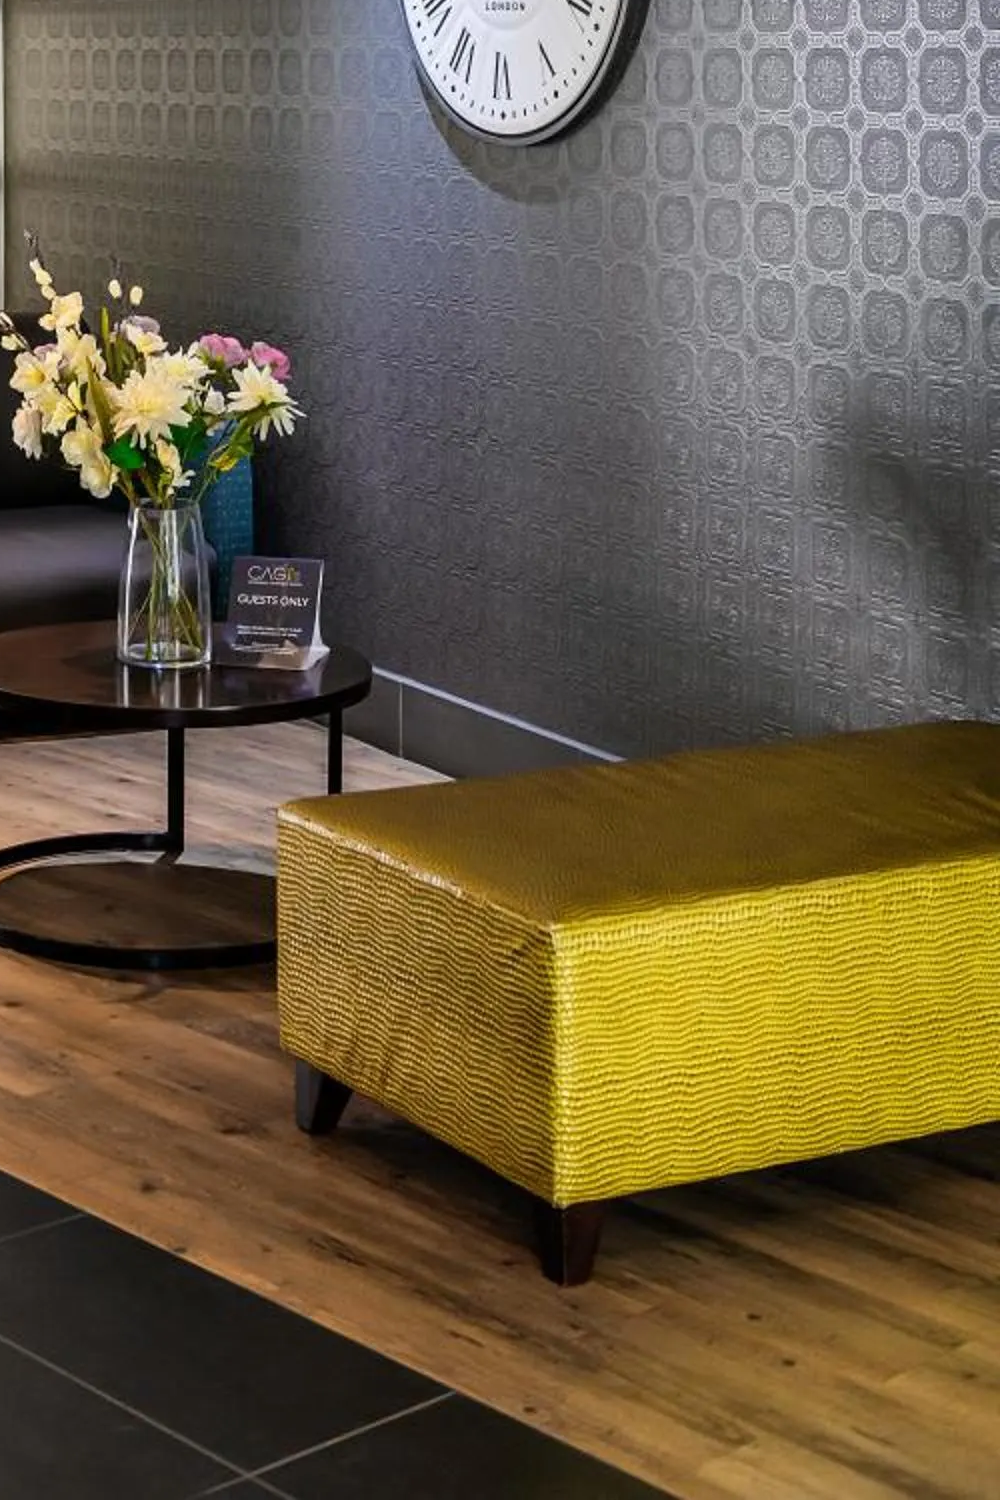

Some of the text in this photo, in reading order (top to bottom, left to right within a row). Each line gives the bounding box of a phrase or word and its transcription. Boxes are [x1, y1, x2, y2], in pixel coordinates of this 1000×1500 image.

[485, 1, 526, 12] LONDON
[237, 593, 310, 607] GUESTS ONLY
